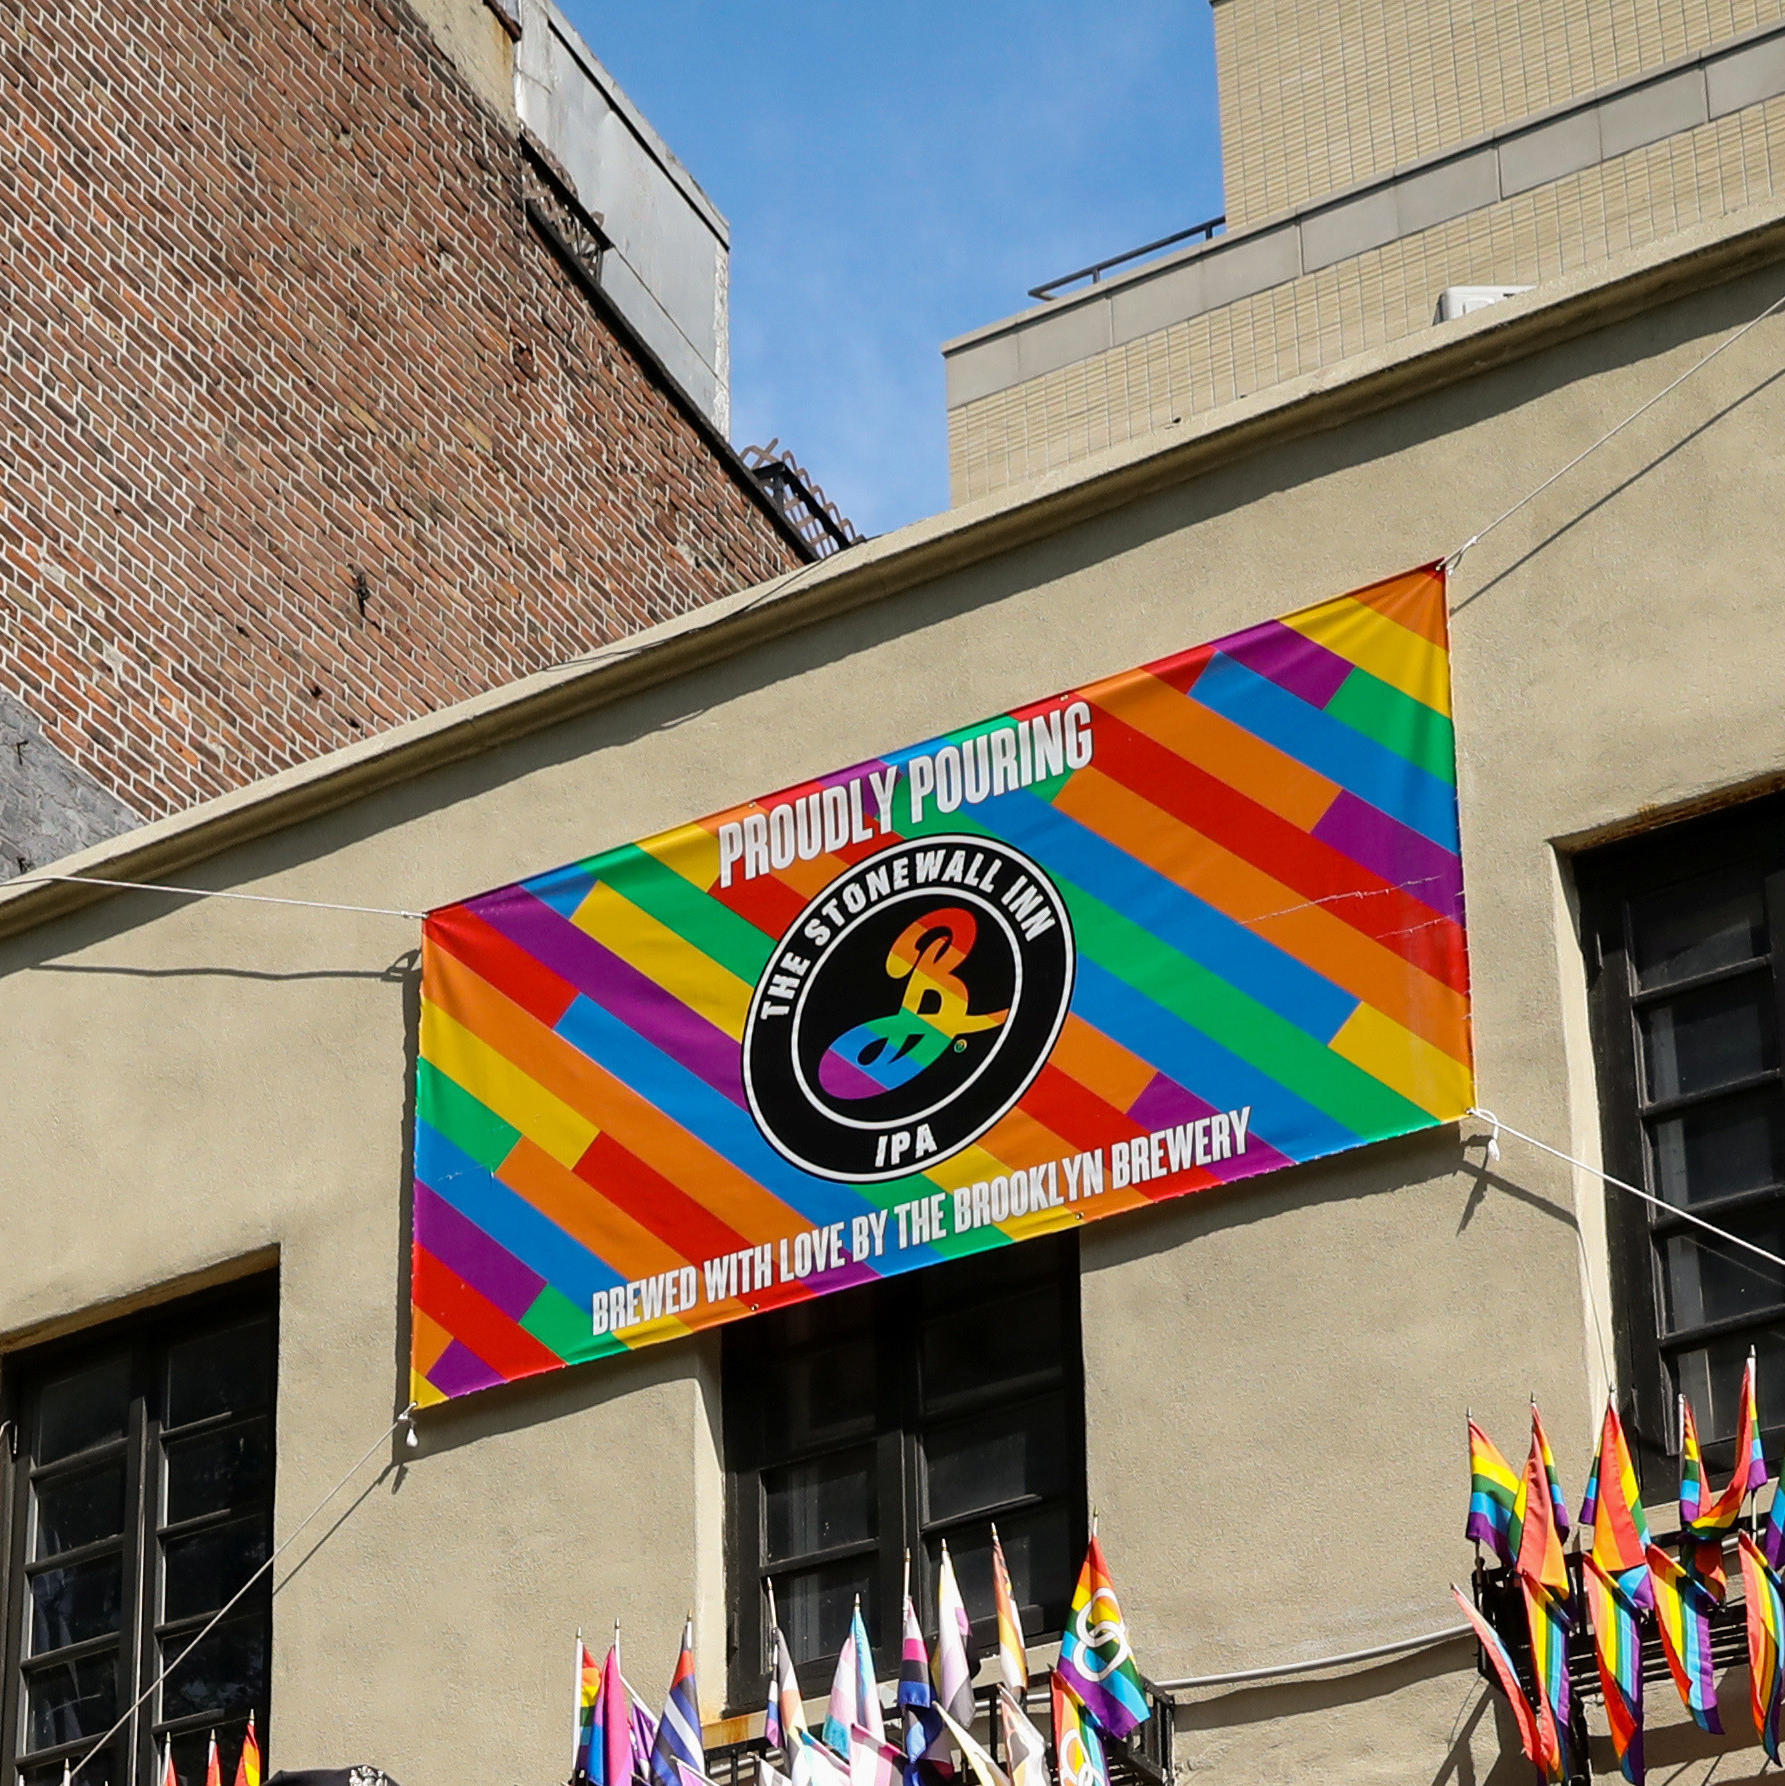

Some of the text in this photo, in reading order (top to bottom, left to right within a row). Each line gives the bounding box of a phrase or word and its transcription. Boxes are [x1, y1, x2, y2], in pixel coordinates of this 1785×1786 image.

[719, 701, 1093, 889] PROUDLY POURING
[760, 849, 1056, 1020] THE STONEWALL INN
[592, 1105, 1251, 1336] BREWED WITH LOVE BY THE BROOKLYN BREWERY
[874, 1123, 938, 1168] IPA
